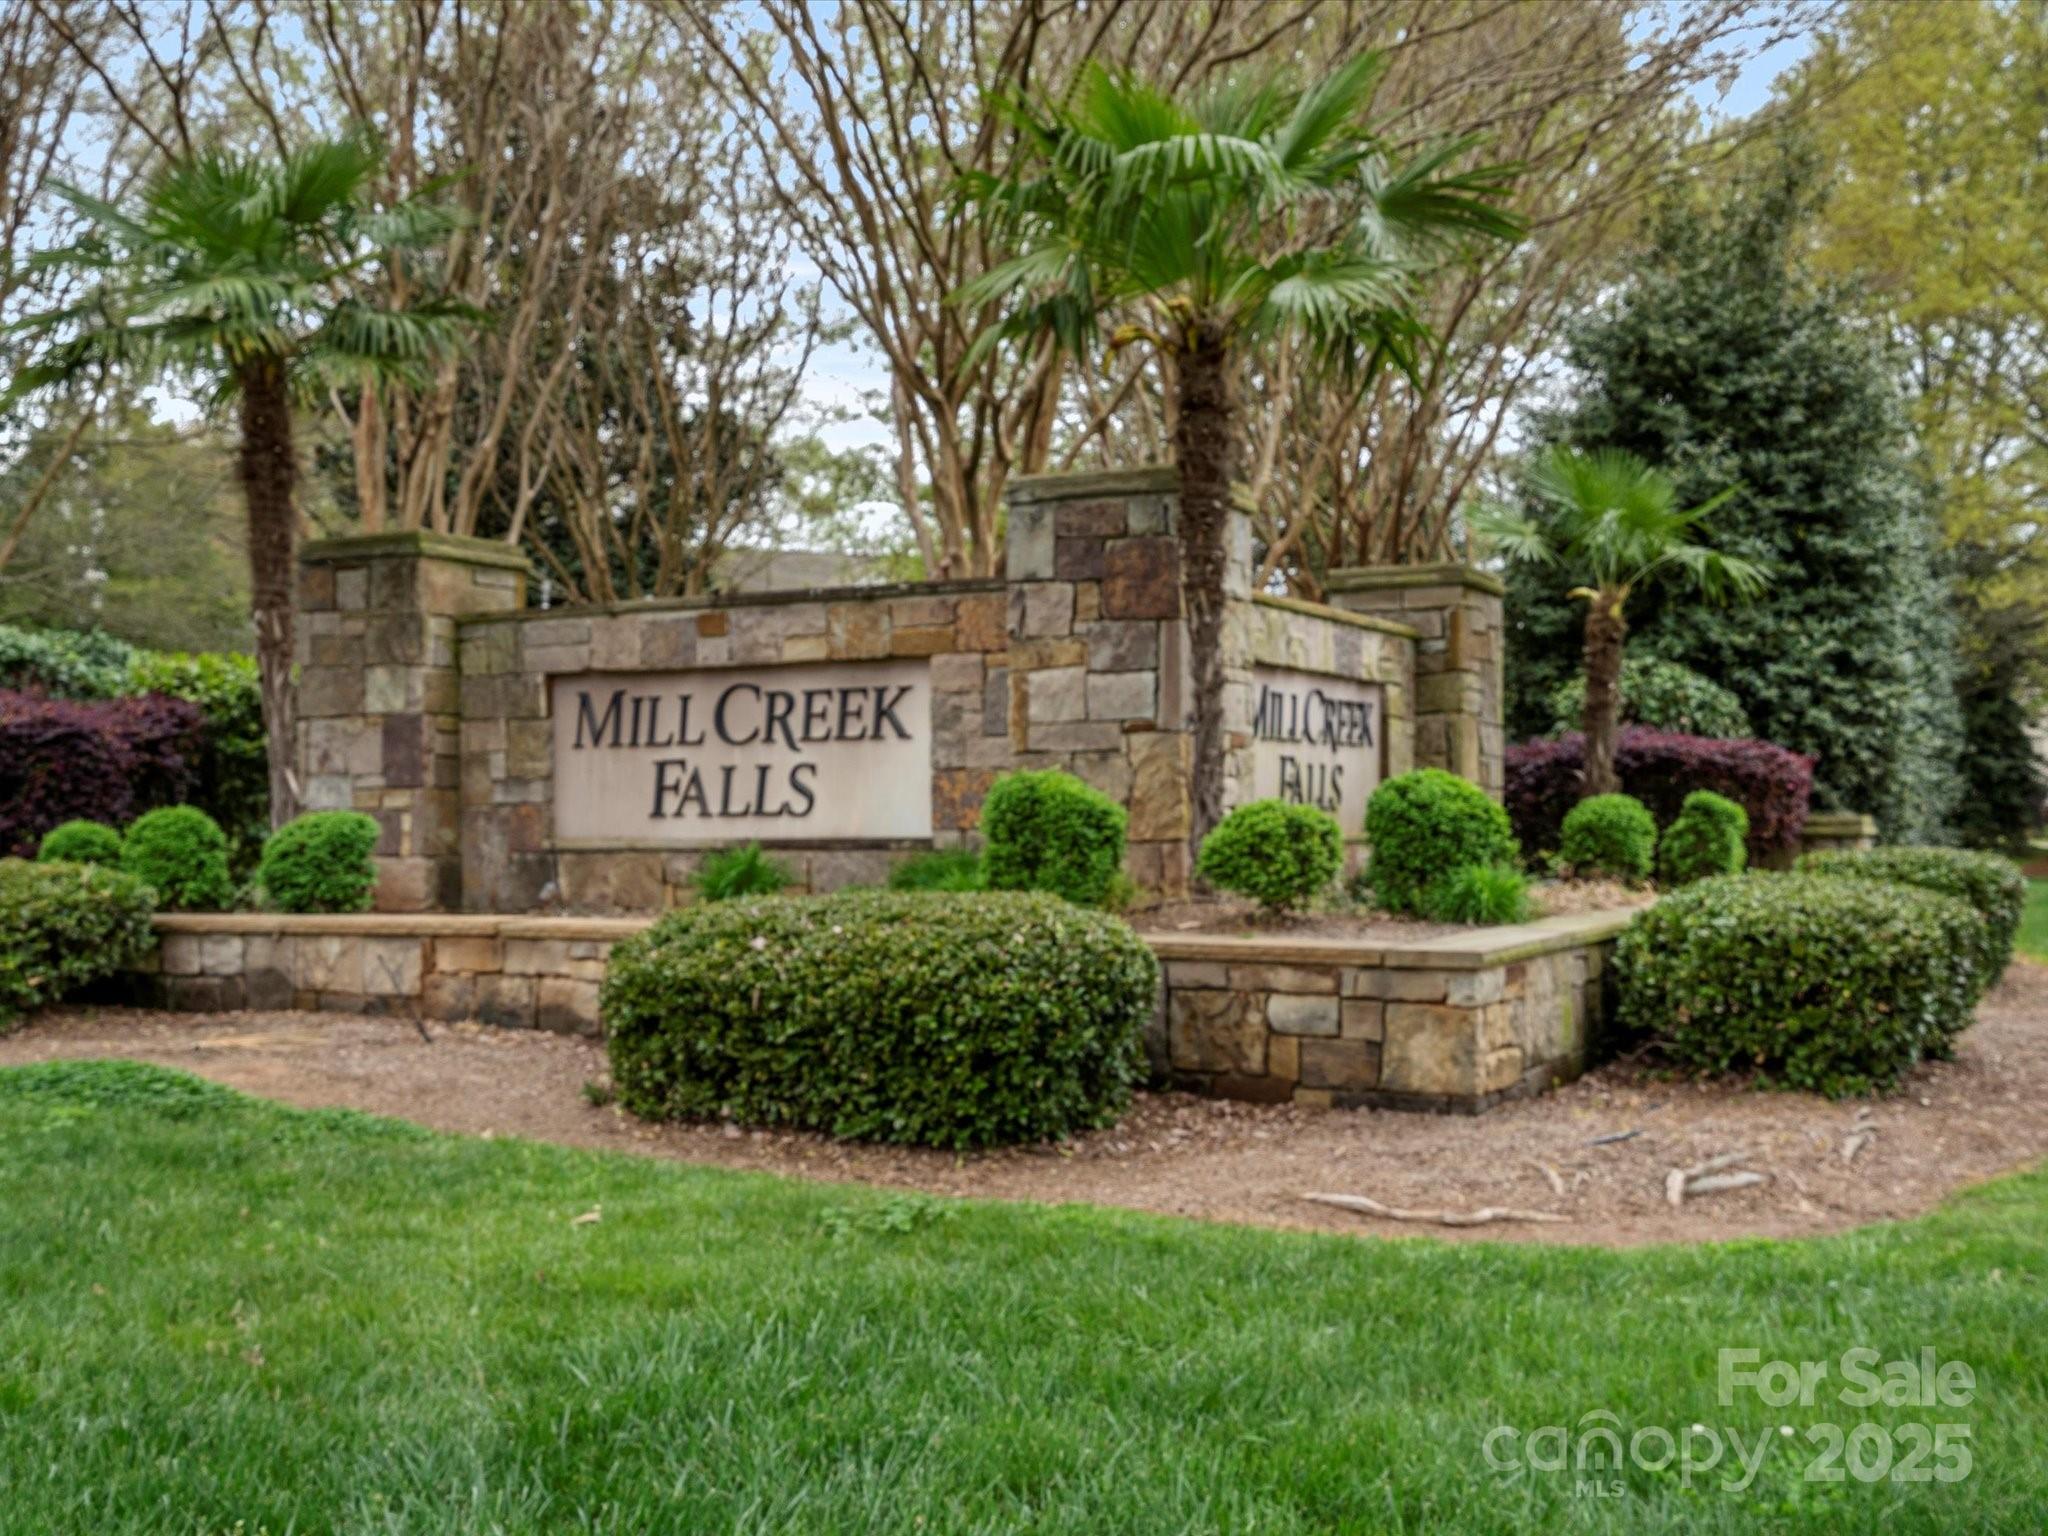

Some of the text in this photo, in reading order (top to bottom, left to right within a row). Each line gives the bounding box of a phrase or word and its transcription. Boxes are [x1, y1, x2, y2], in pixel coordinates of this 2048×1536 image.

[572, 682, 915, 752] MILL CREEK
[1303, 688, 1374, 754] CREEK
[648, 758, 817, 819] FALLS
[1279, 755, 1343, 813] FALLS
